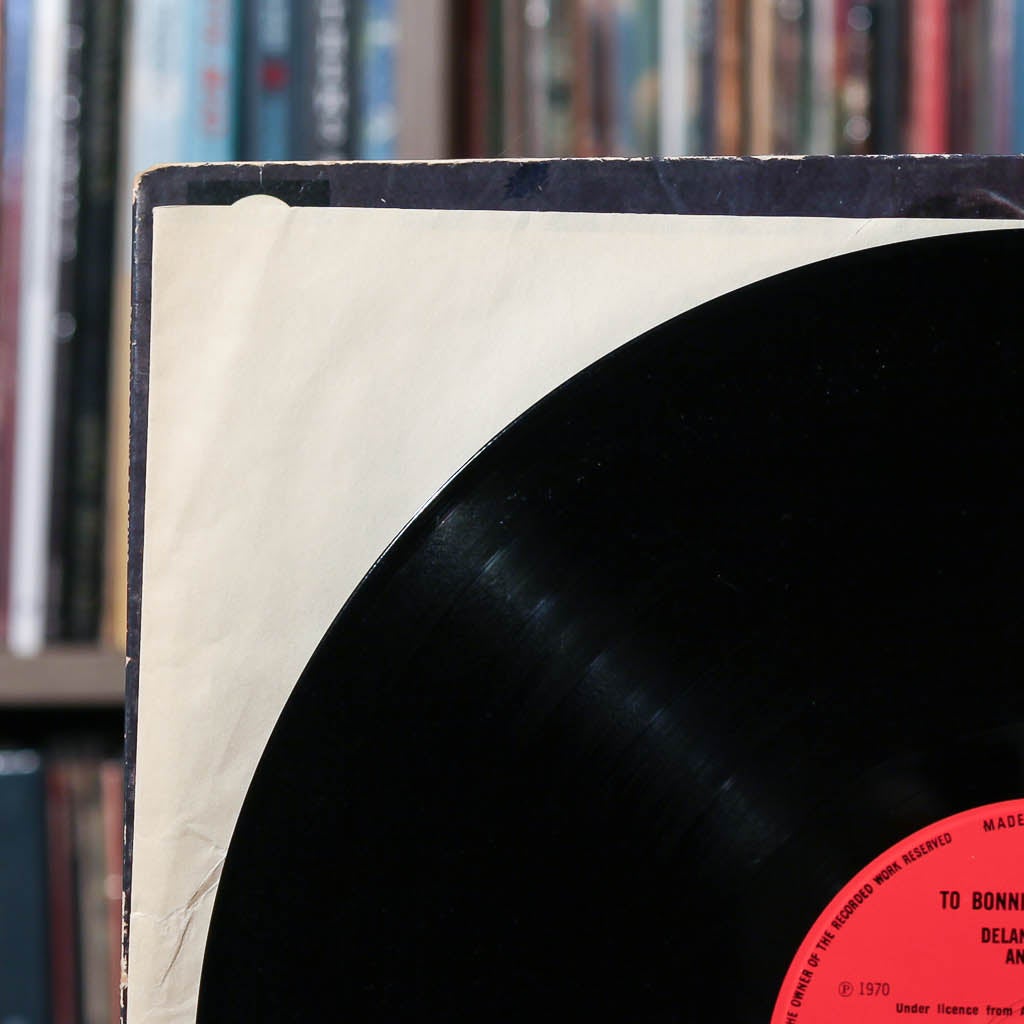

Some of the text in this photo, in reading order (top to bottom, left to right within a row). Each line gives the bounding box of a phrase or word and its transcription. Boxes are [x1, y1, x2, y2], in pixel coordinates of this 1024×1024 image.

[982, 813, 1024, 833] MADE
[940, 891, 960, 910] TO
[790, 968, 814, 1007] OWNER
[806, 951, 822, 968] OF
[815, 930, 835, 952] THE
[830, 883, 875, 930] RECORDED
[872, 860, 902, 887] WORK
[901, 831, 952, 865] RESERVED
[859, 982, 890, 996] 1970
[896, 1003, 930, 1014] Under
[938, 1005, 979, 1015] licence
[987, 1005, 1013, 1016] from
